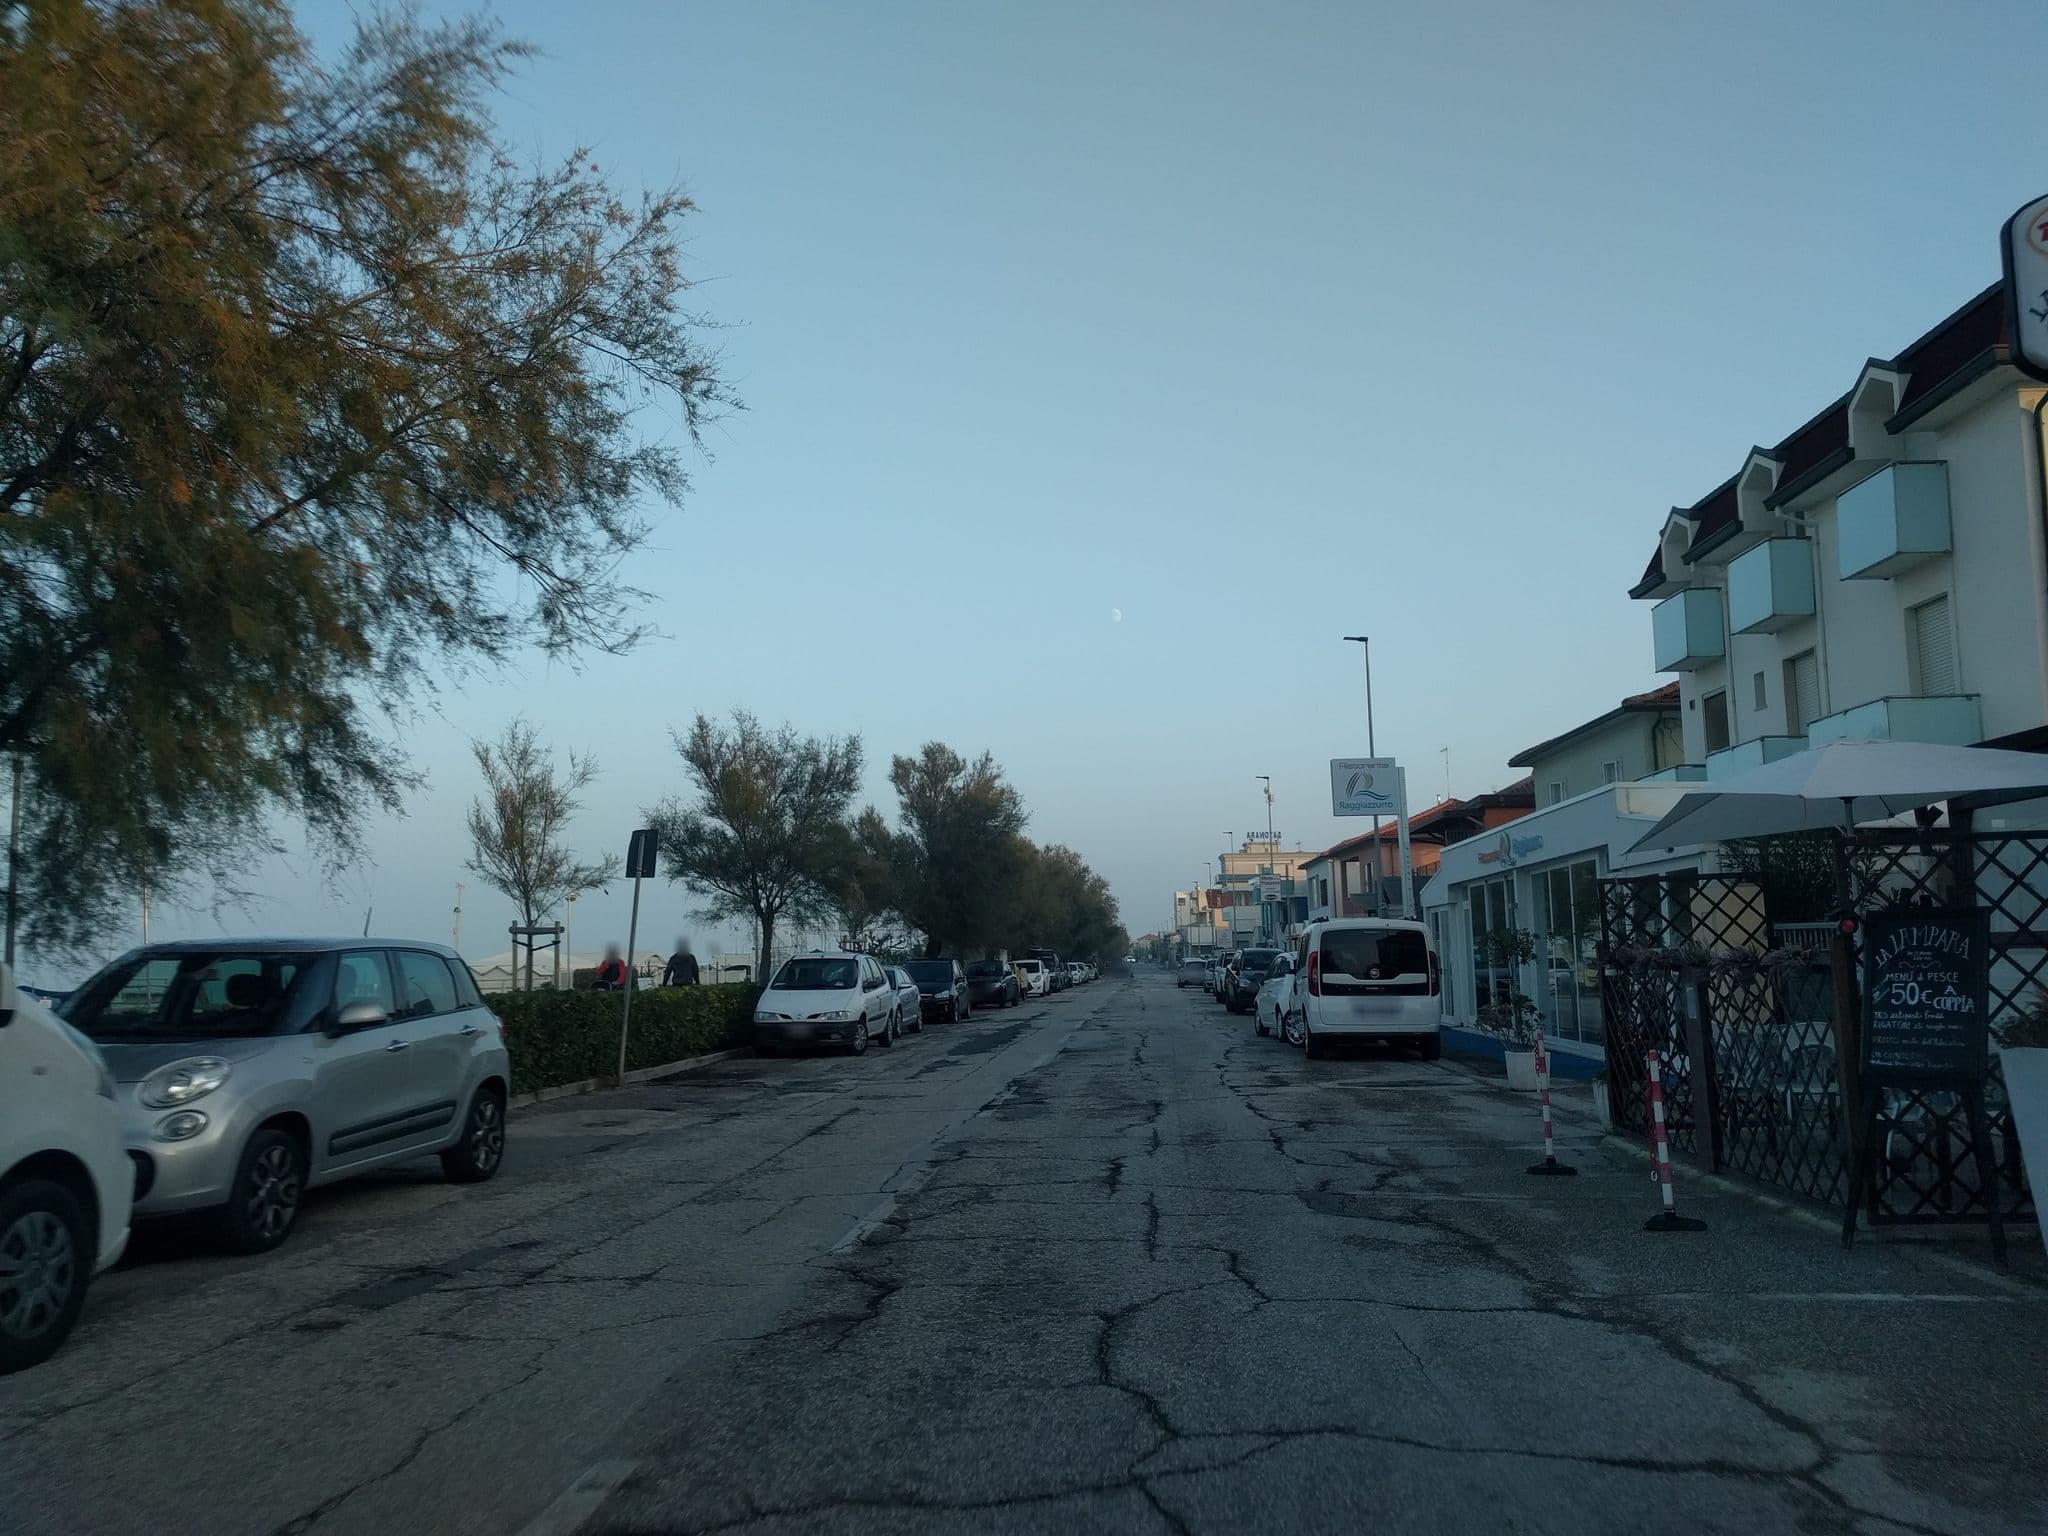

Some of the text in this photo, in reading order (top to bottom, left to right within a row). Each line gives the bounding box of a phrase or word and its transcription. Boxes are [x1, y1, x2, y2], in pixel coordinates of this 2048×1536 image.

[1338, 801, 1393, 811] Raggiazzurro
[1875, 925, 1970, 968] LA LAMPARA
[1927, 971, 1959, 982] PESCE
[1933, 995, 1976, 1013] COPPIA
